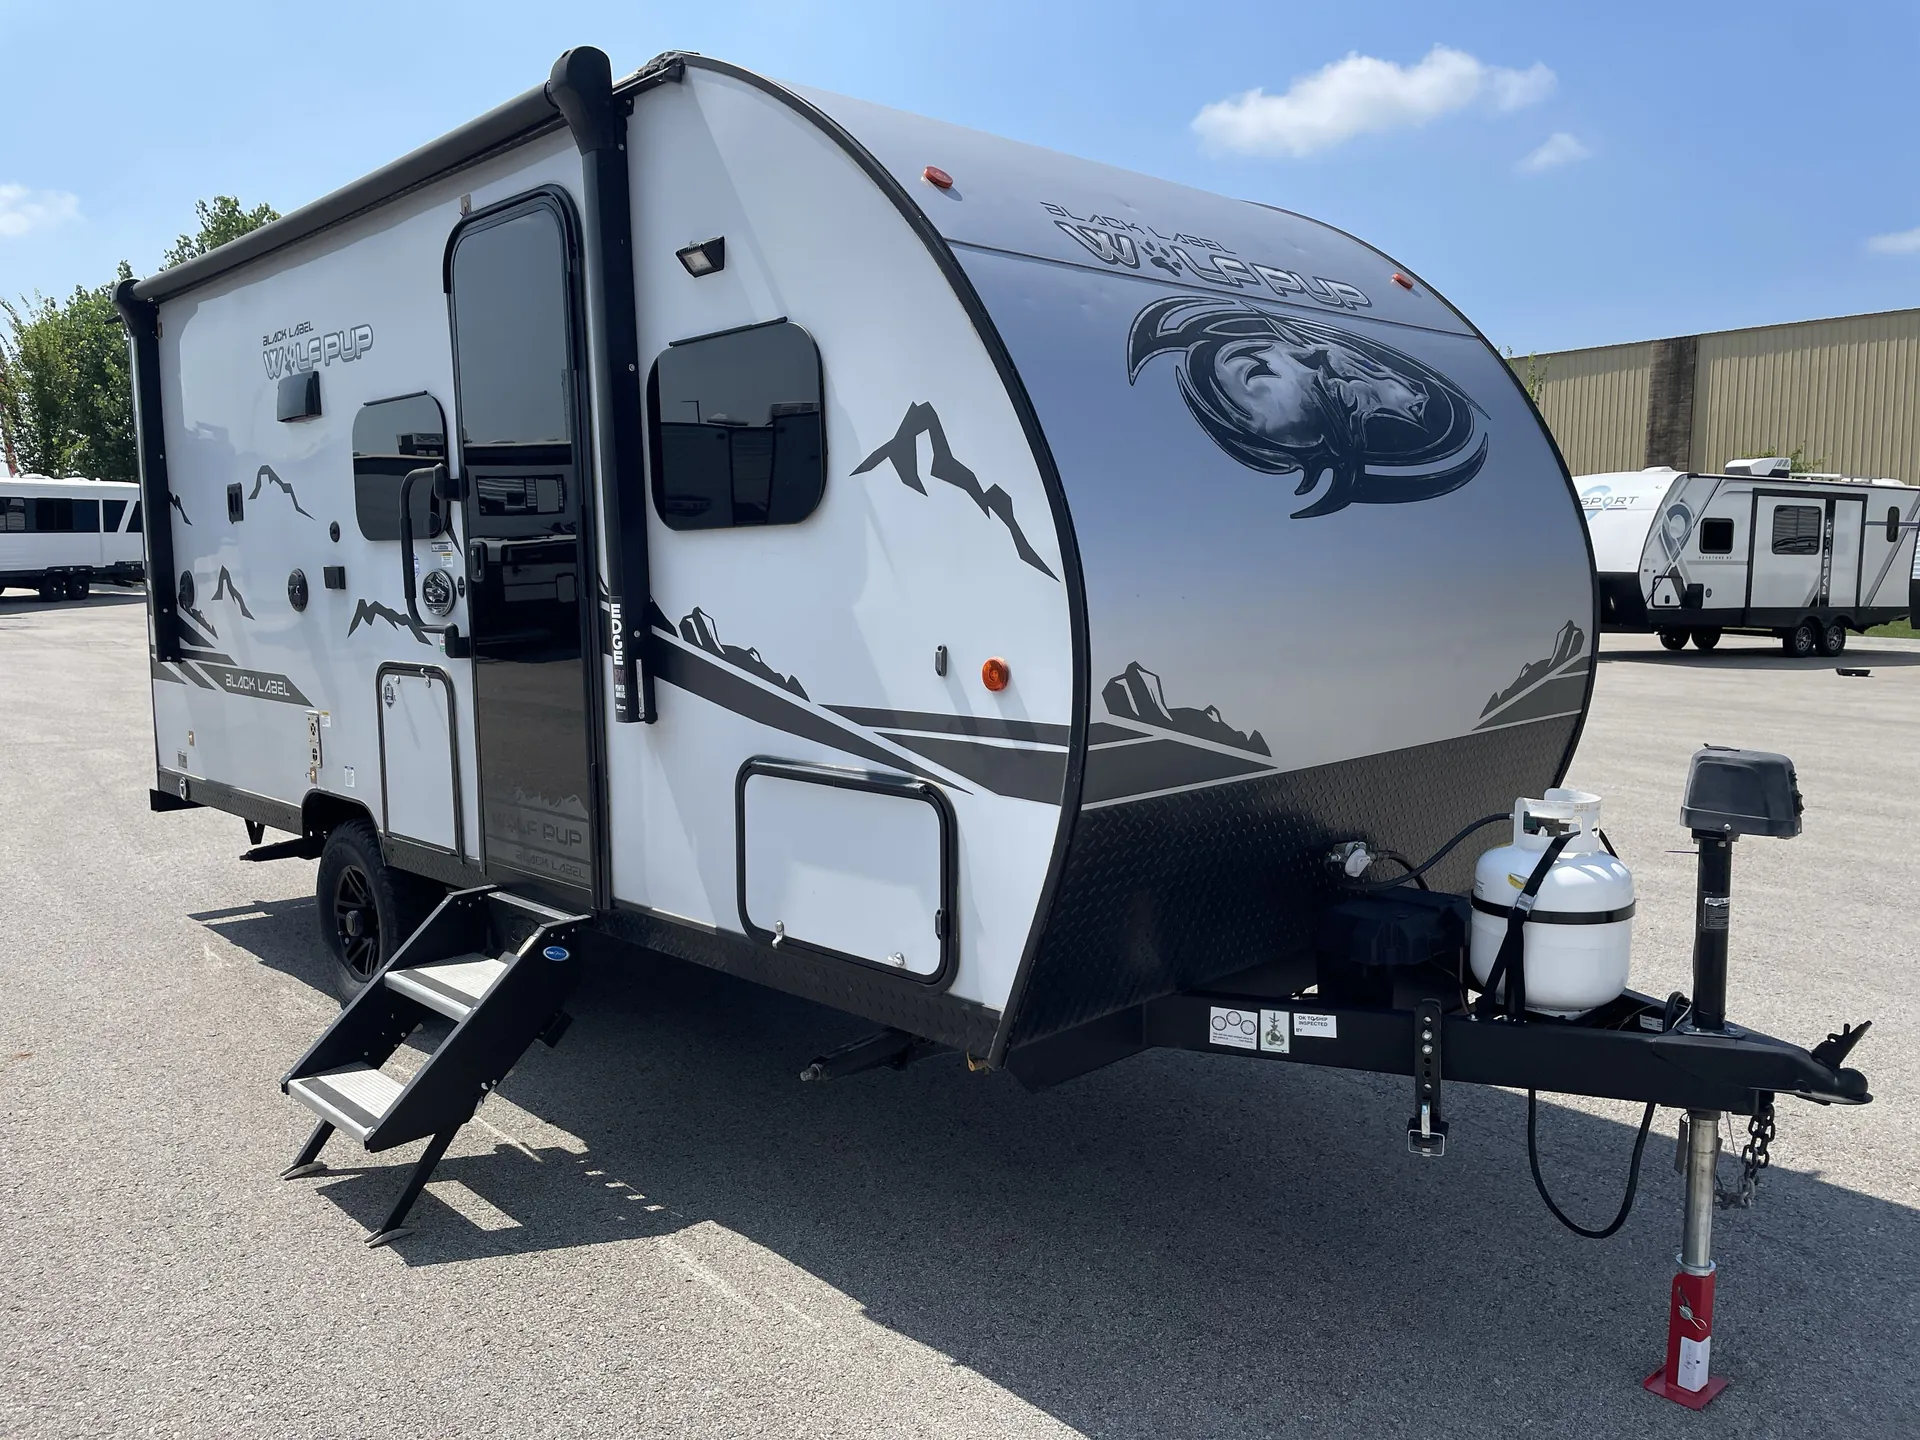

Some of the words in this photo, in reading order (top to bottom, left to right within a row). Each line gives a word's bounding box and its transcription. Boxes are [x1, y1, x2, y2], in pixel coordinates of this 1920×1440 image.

[1040, 201, 1145, 235] BLACK
[1147, 226, 1237, 254] LABEL
[1252, 262, 1373, 310] PUP
[263, 329, 287, 346] BLACK
[288, 321, 314, 338] LABEL
[324, 324, 374, 366] PUP
[611, 604, 624, 666] EDGE
[225, 673, 256, 691] BLACK
[258, 680, 291, 696] LABEL
[543, 822, 583, 847] PUP
[551, 861, 586, 878] LABEL
